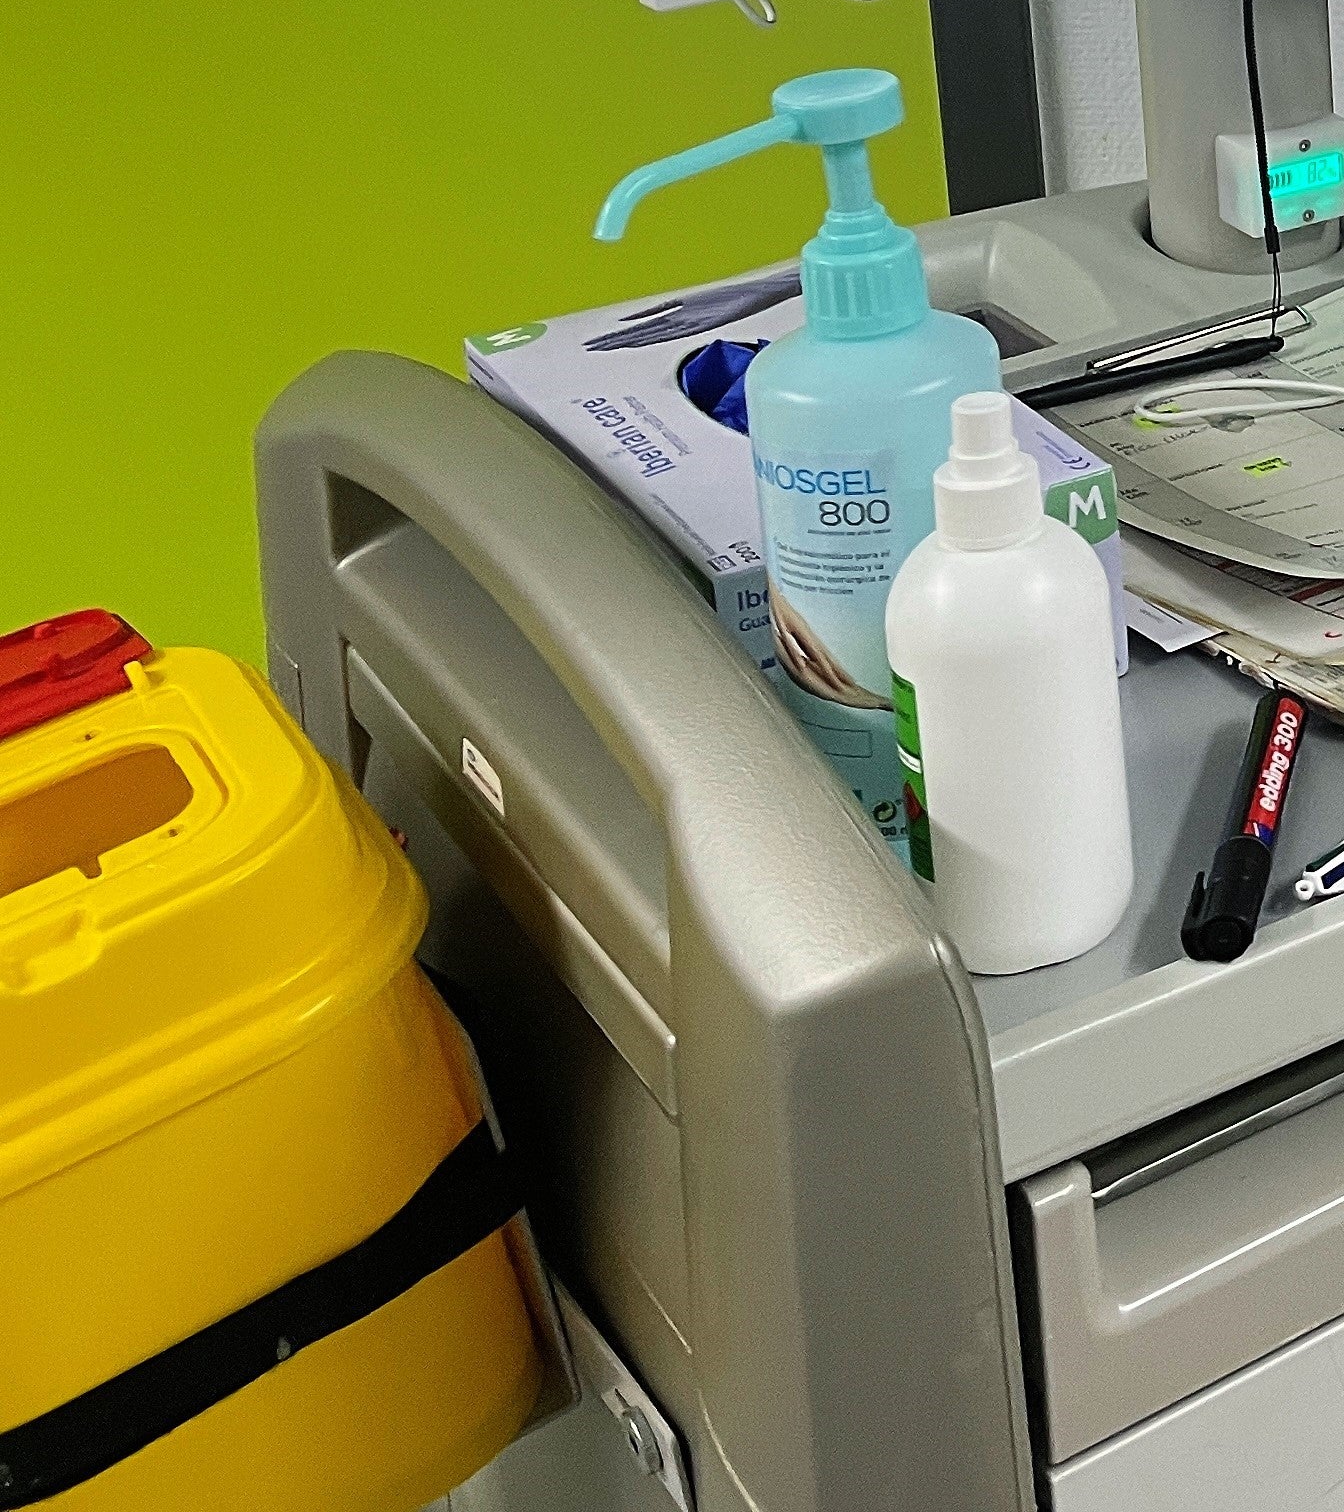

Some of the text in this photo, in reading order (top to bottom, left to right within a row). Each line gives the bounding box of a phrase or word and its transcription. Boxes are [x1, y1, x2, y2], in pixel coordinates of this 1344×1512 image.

[583, 397, 677, 477] Iberian care
[753, 453, 887, 496] NIOSGEL
[819, 499, 890, 526] 800
[1068, 486, 1107, 529] M
[1260, 711, 1299, 813] edding 300
